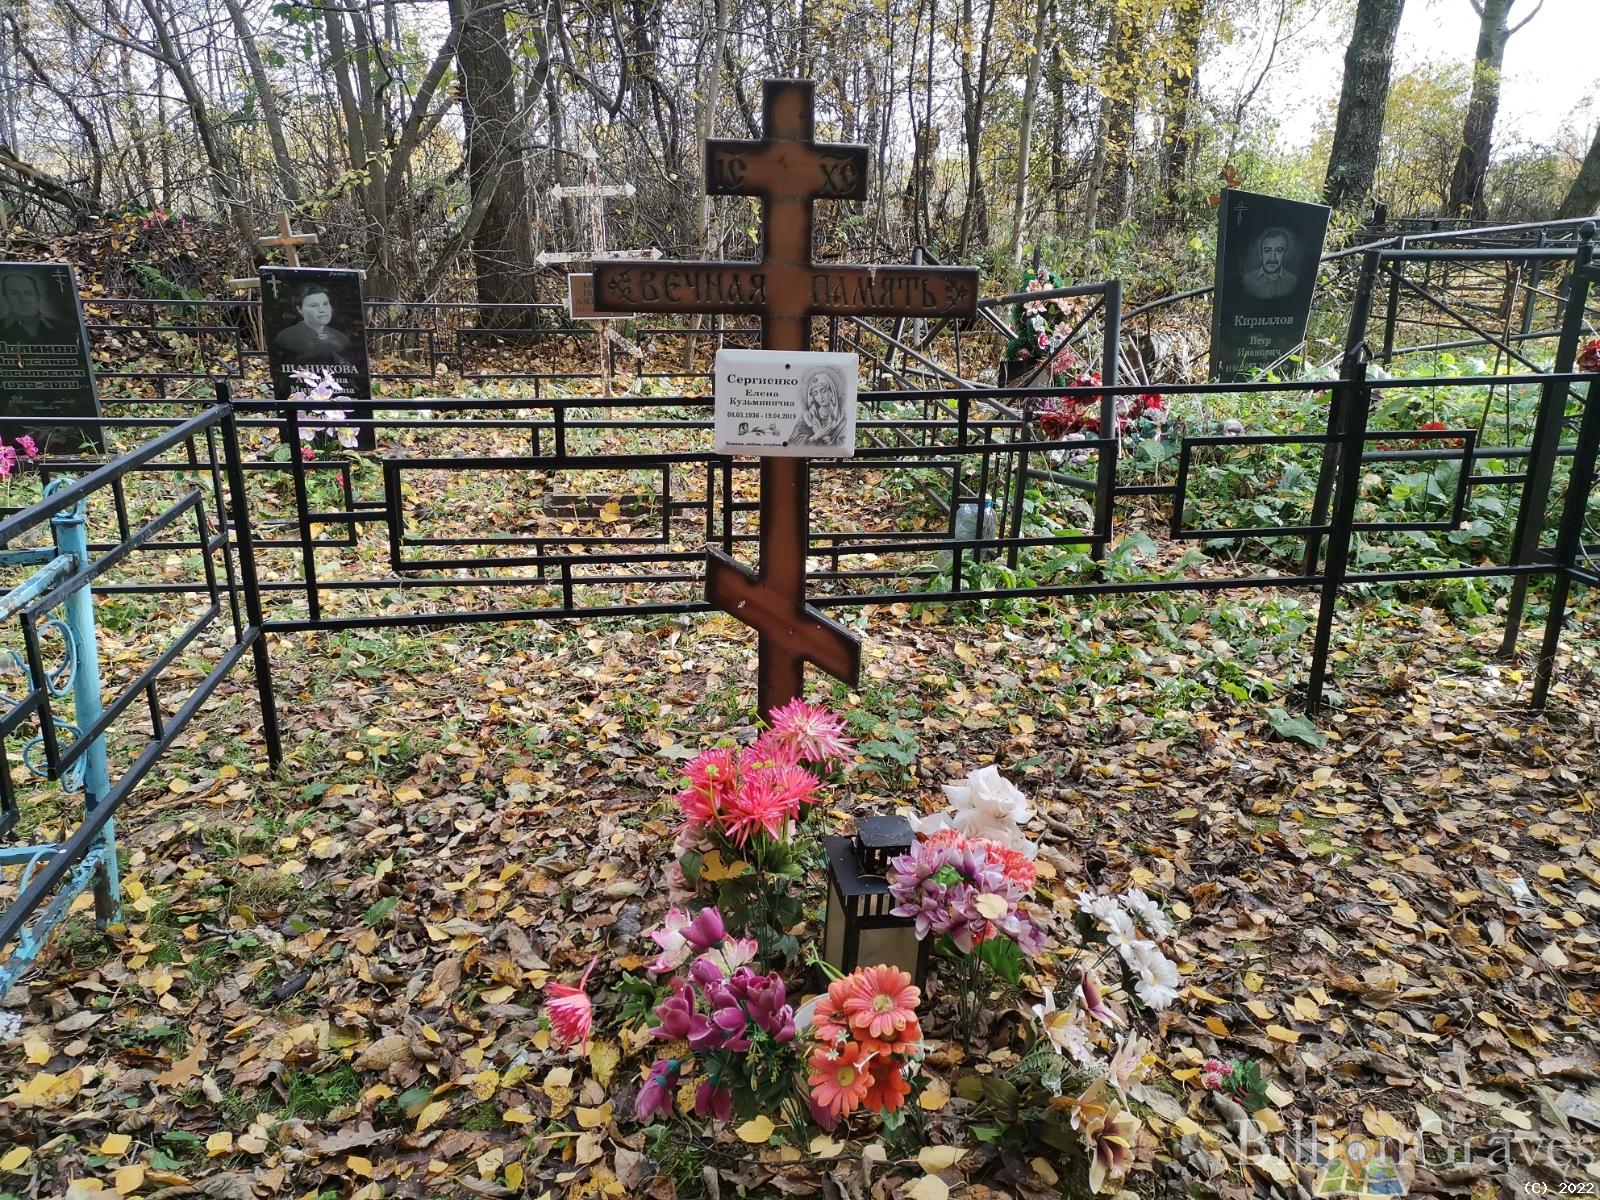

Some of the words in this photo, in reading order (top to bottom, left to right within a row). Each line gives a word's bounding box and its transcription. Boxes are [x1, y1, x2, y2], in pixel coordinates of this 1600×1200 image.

[639, 271, 767, 304] ВЕЧНАЯ
[811, 274, 938, 310] ПАМЯТЬ
[1233, 315, 1294, 328] Кириллов
[727, 374, 799, 386] Сергиенко
[745, 389, 779, 397] Елена
[729, 397, 795, 407] Кузьминична
[727, 411, 760, 419] 08.03.1936
[765, 412, 797, 420] 19.04.2019
